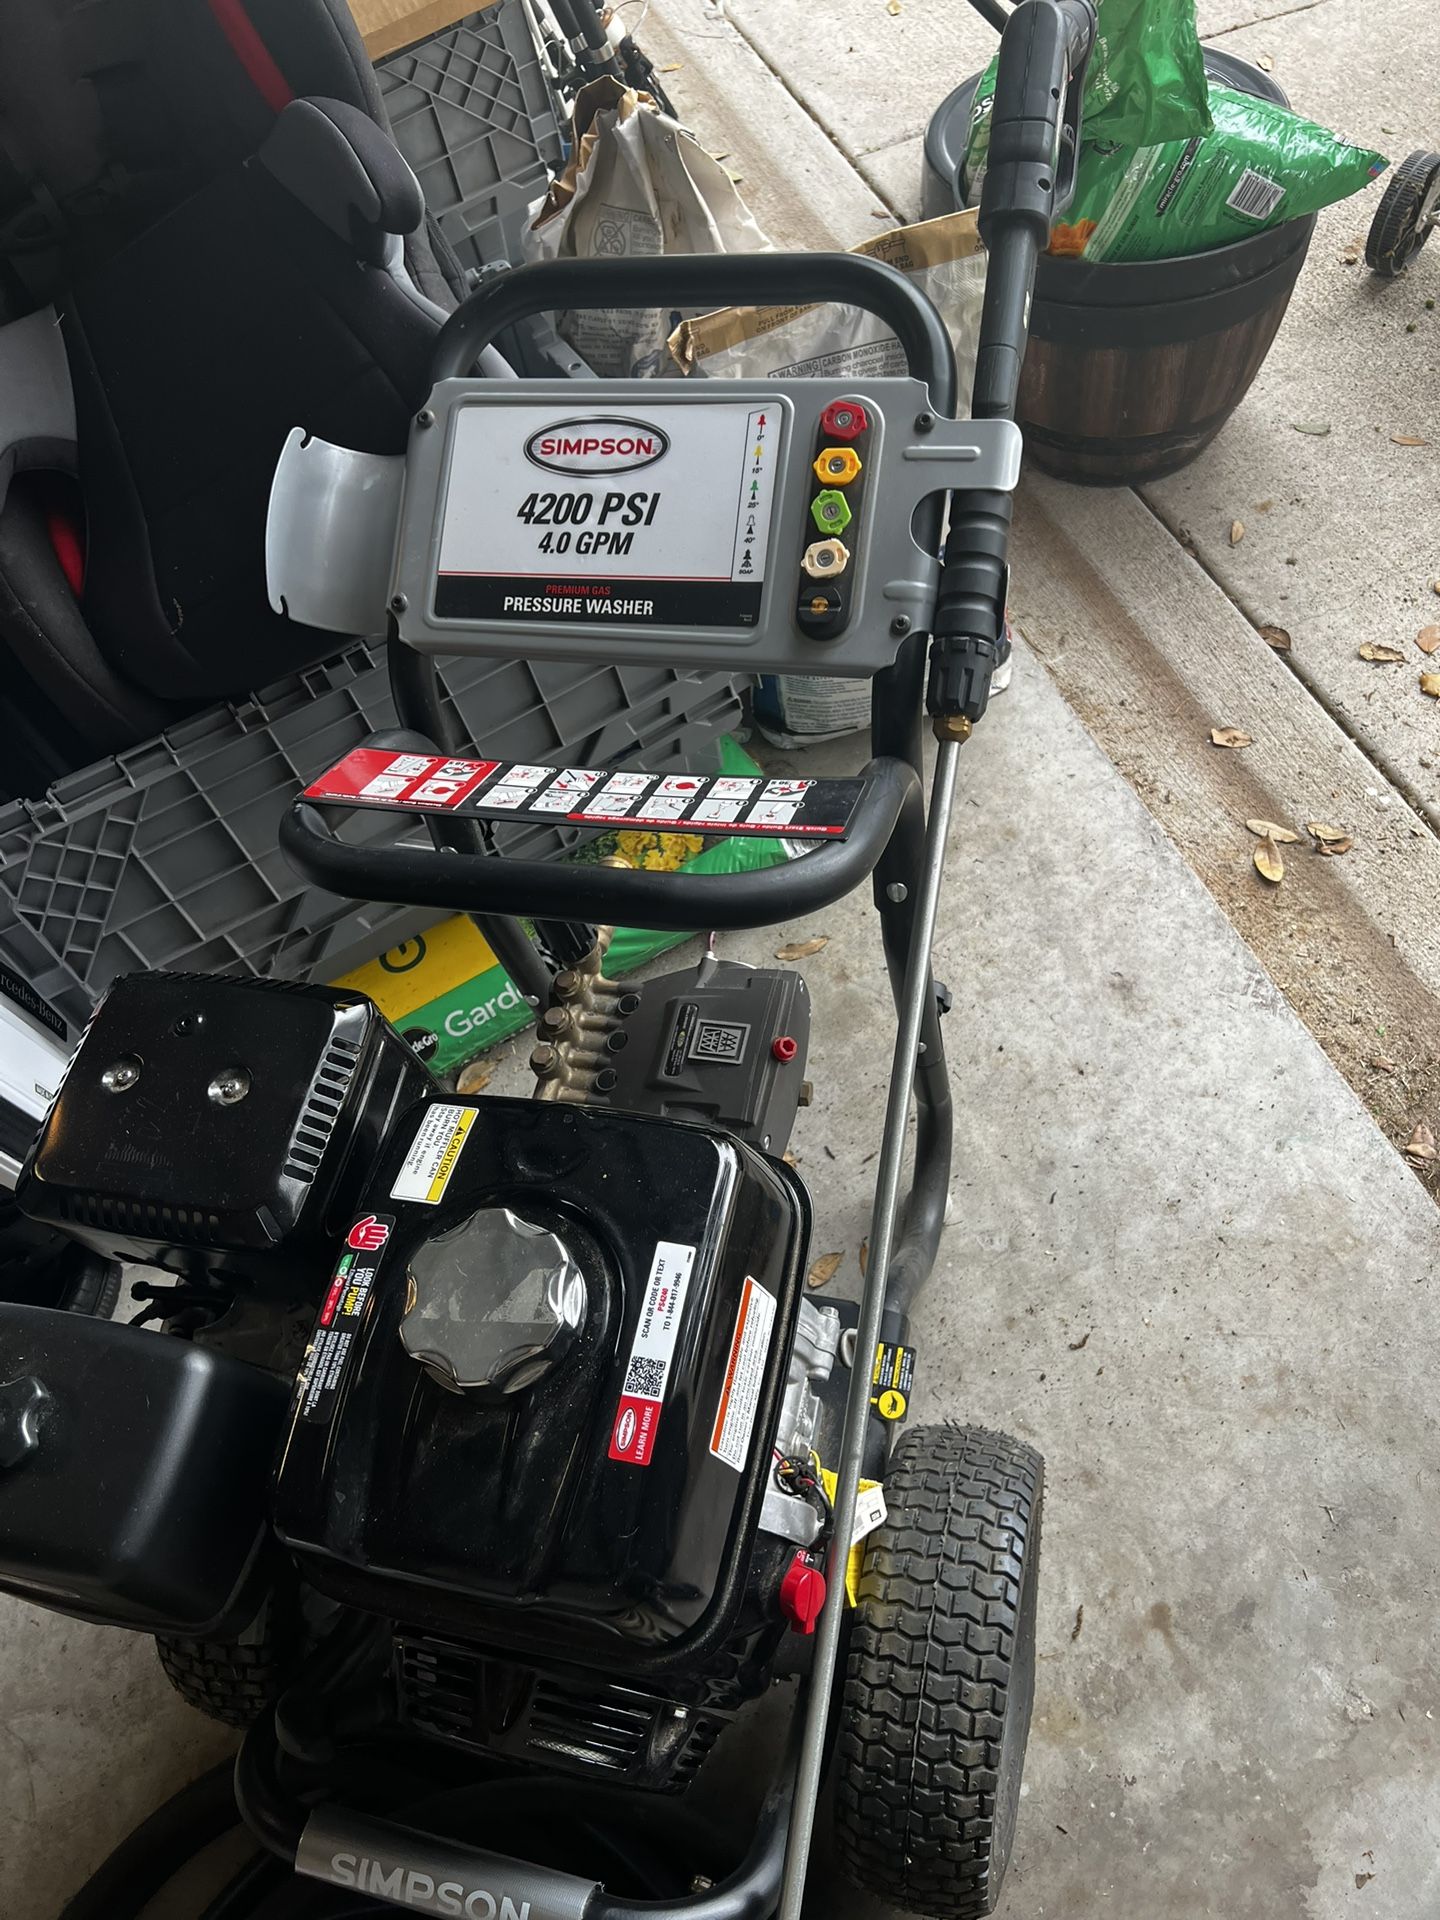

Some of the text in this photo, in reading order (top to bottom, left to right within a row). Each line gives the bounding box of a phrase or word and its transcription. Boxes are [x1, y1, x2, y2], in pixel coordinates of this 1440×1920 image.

[1159, 153, 1191, 209] miracle-gro.com
[822, 352, 853, 367] CARBON
[852, 343, 890, 360] MONOXIDE
[779, 361, 819, 378] WARNING
[540, 438, 654, 456] SIMPSON
[517, 491, 661, 526] 4200 PSI
[538, 531, 635, 555] 4.0 GPM
[545, 584, 611, 596] PREMIUM GAS
[503, 597, 654, 615] PRESSURE WASHER
[444, 981, 523, 1038] Gard
[429, 1106, 439, 1118] has
[434, 1107, 447, 1122] Stay
[420, 1120, 433, 1136] been
[425, 1123, 439, 1141] away
[431, 1108, 454, 1148] BURN YOU.
[426, 1109, 462, 1178] HOT MUFFLER CAN
[410, 1150, 427, 1174] engine
[436, 1138, 460, 1179] CAUTION
[341, 1267, 366, 1315] YOU PUMP!
[350, 1268, 374, 1316] LOOK BEFORE
[641, 1258, 666, 1338] SCAN QR CODE OR TEXT
[657, 1286, 669, 1311] PS4240
[662, 1271, 682, 1330] TO 1-844-817-9946
[727, 1330, 742, 1381] WARNING
[727, 1386, 735, 1410] highly
[746, 1386, 754, 1413] Manual
[619, 1410, 633, 1446] SIMPSON
[634, 1404, 653, 1460] LEARN MORE
[726, 1408, 736, 1436] engine
[730, 1415, 739, 1442] engine
[330, 1852, 531, 1920] SIMPSON
